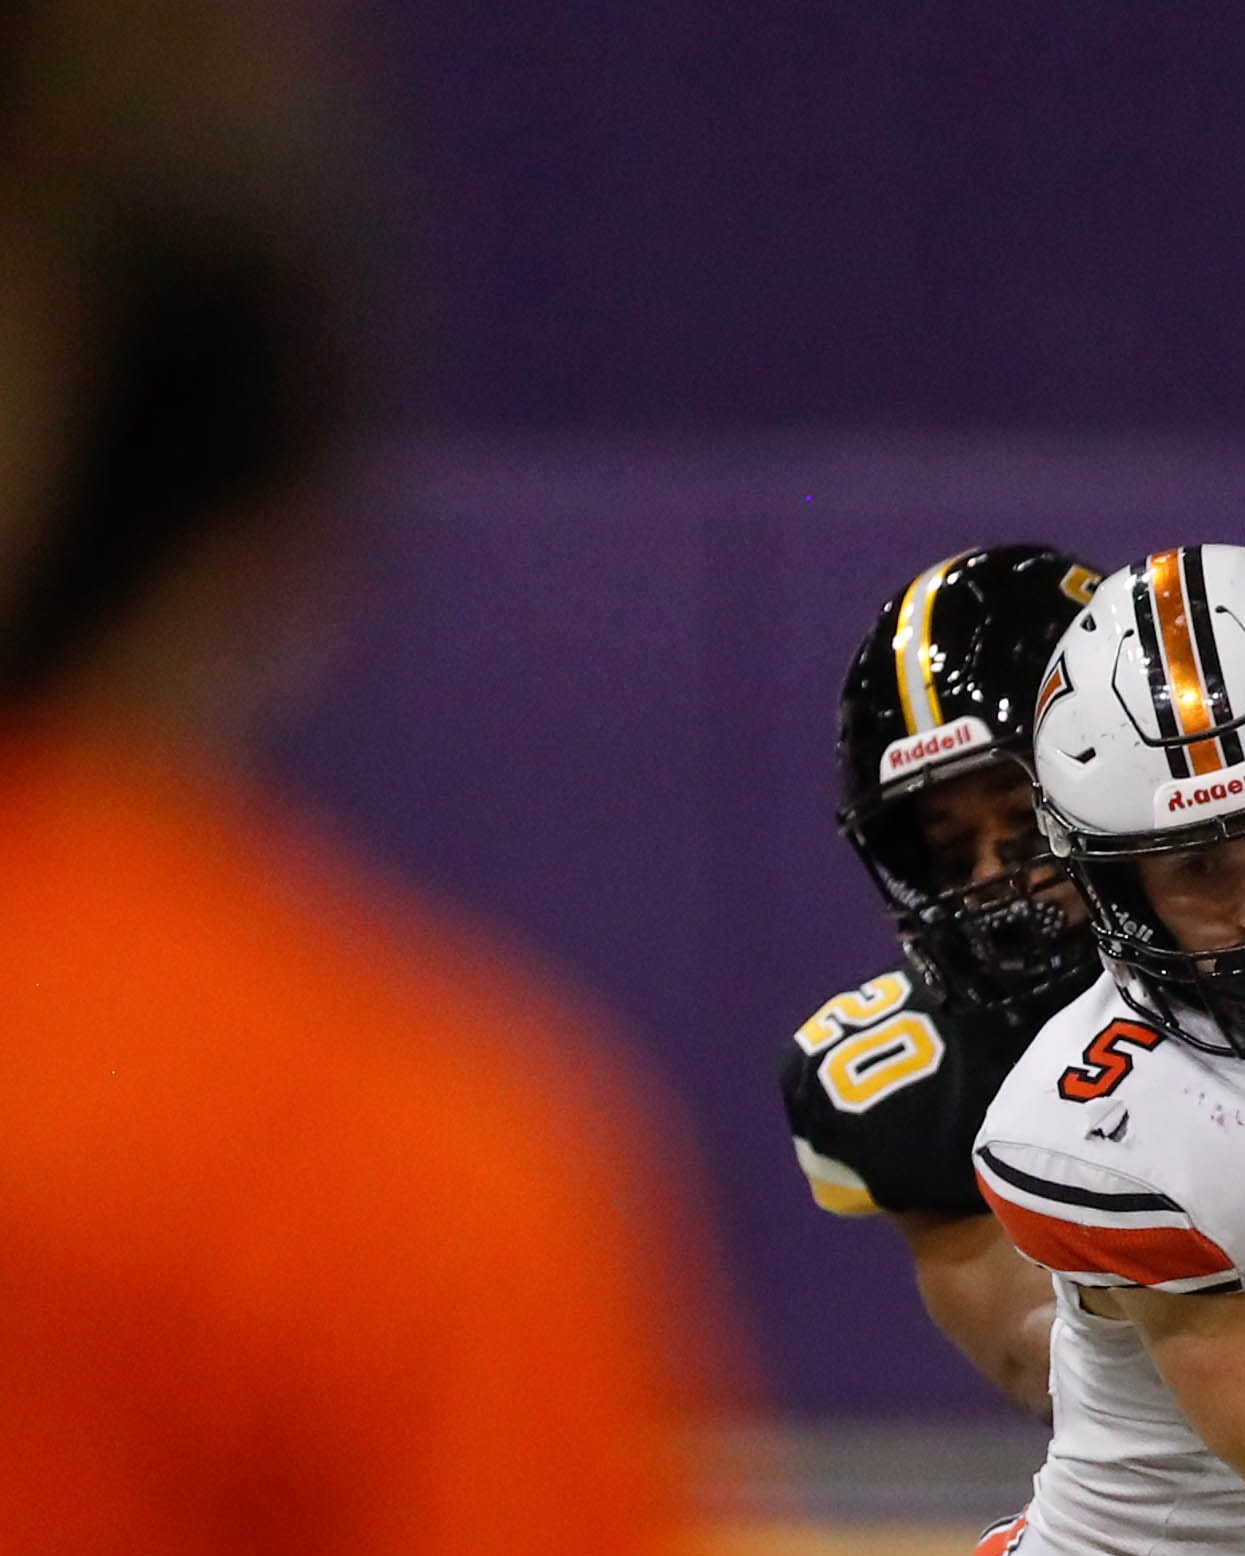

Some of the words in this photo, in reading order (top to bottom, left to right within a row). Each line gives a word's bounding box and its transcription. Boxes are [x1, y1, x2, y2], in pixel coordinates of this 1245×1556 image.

[889, 723, 971, 769] Riddell
[794, 970, 945, 1114] 20
[1057, 1018, 1166, 1102] 5
